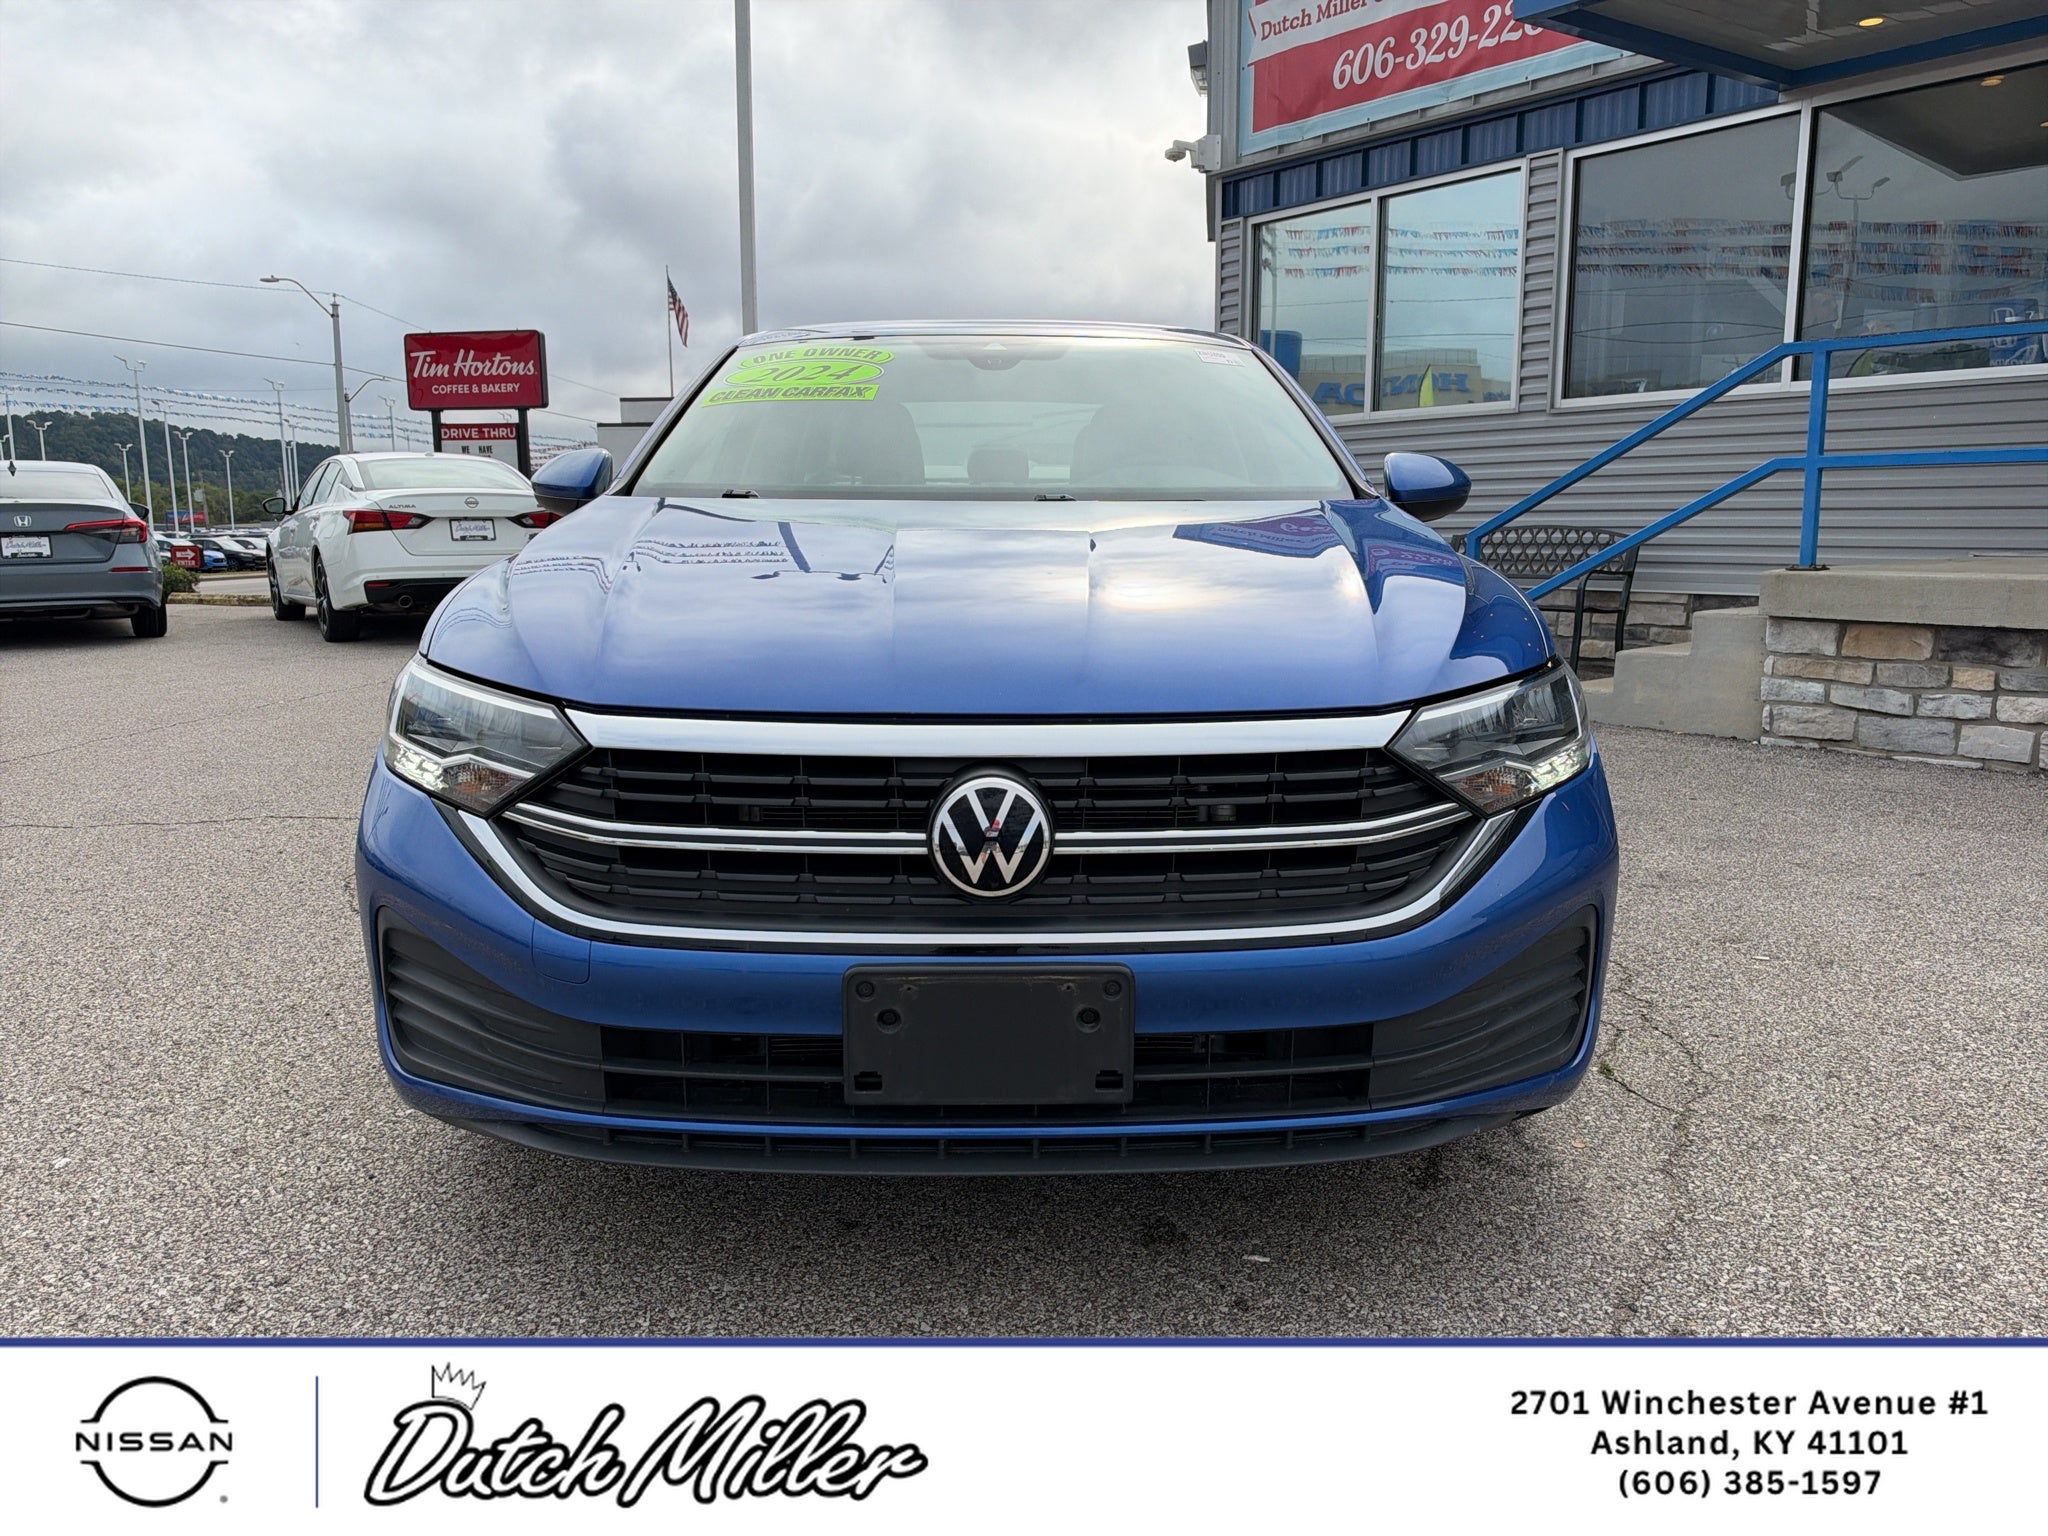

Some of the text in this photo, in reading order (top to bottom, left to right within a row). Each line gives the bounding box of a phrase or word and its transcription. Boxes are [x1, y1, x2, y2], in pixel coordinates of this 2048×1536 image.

[1261, 0, 1368, 41] Dutch Miller
[1333, 0, 1544, 90] 606-329-22
[410, 348, 535, 378] Tim Hortons
[753, 347, 883, 364] ONE OWNER
[742, 364, 864, 383] 2024
[432, 383, 520, 394] COFFEE & BAKERY
[709, 386, 873, 402] CLEAN CARFAX
[441, 427, 516, 439] DRIVE THRU
